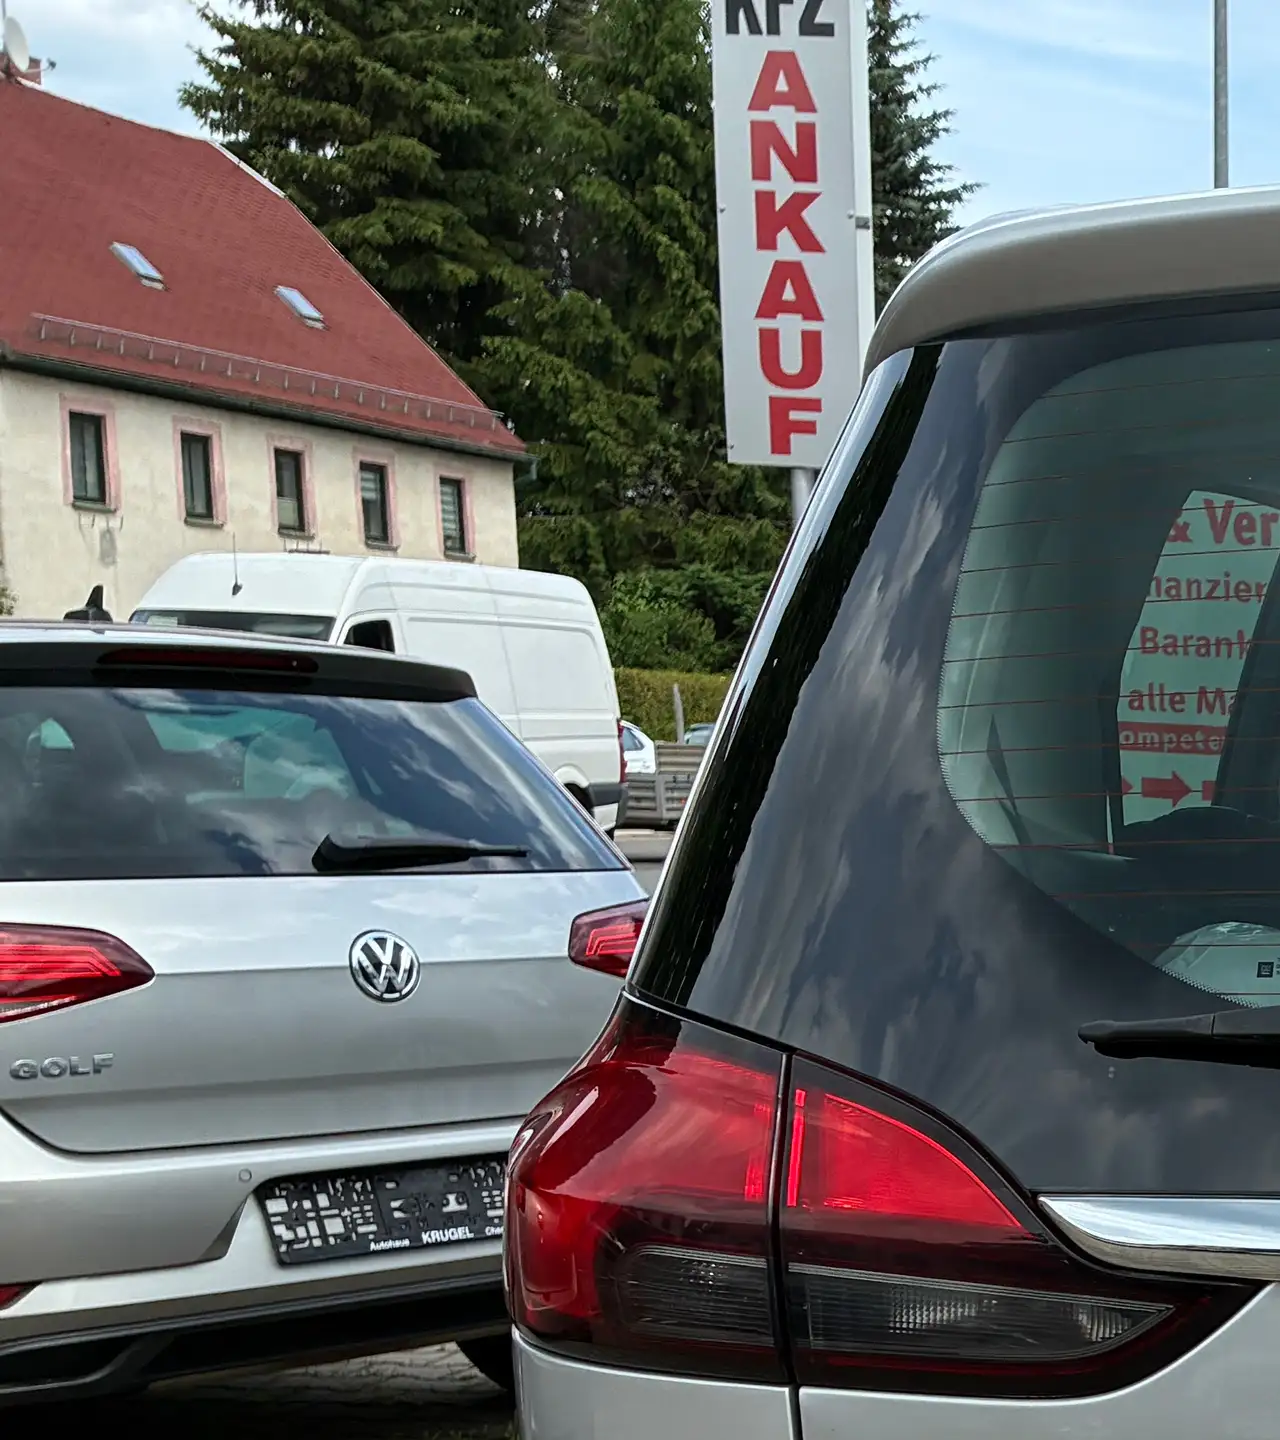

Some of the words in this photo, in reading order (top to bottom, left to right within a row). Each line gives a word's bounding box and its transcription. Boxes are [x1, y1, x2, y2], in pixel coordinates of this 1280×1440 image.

[747, 50, 827, 456] ANKAUF
[1128, 682, 1186, 712] alle
[9, 1052, 114, 1080] GOLF
